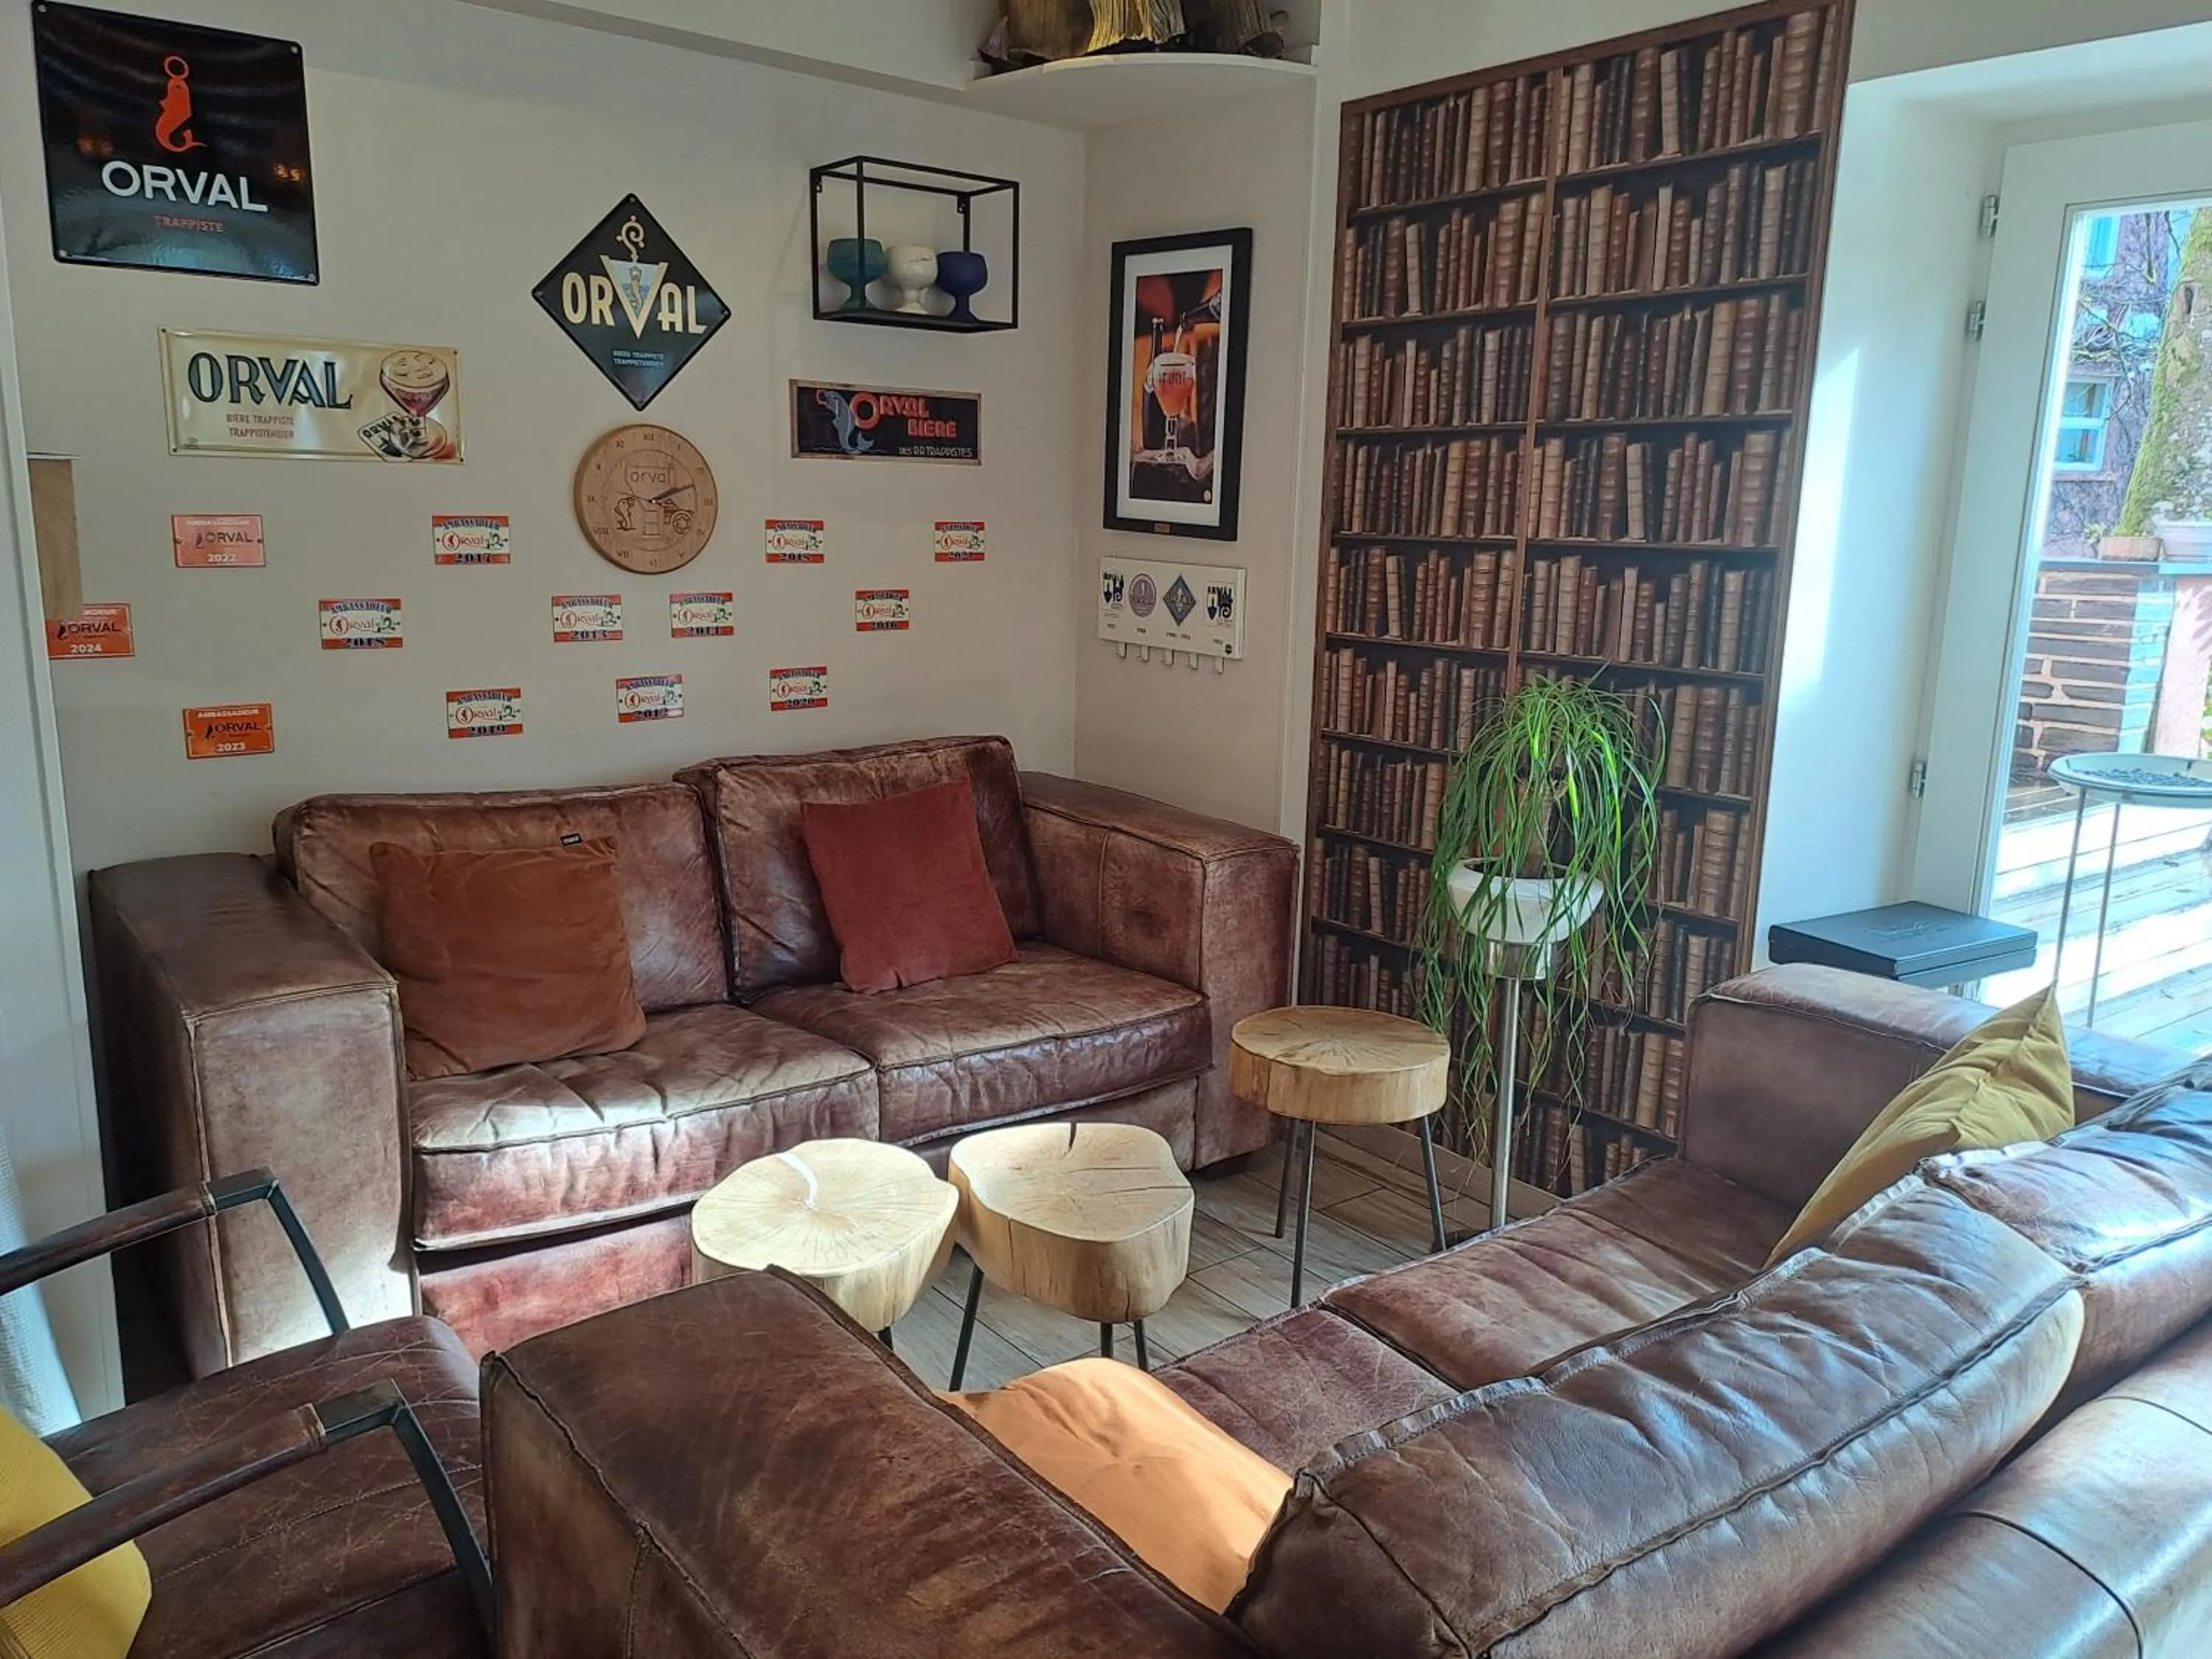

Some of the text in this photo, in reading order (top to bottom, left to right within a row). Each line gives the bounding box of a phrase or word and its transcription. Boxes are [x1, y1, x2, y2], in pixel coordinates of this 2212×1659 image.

[102, 161, 268, 212] ORVAL
[153, 215, 223, 232] TRAPPISTE
[562, 254, 708, 338] ORVAL
[188, 352, 353, 410] ORVAL
[850, 392, 930, 430] ORVAL
[205, 532, 254, 543] ORVAL
[67, 622, 122, 634] ORVAL
[70, 644, 102, 654] 2024
[215, 722, 261, 733] ORVAL
